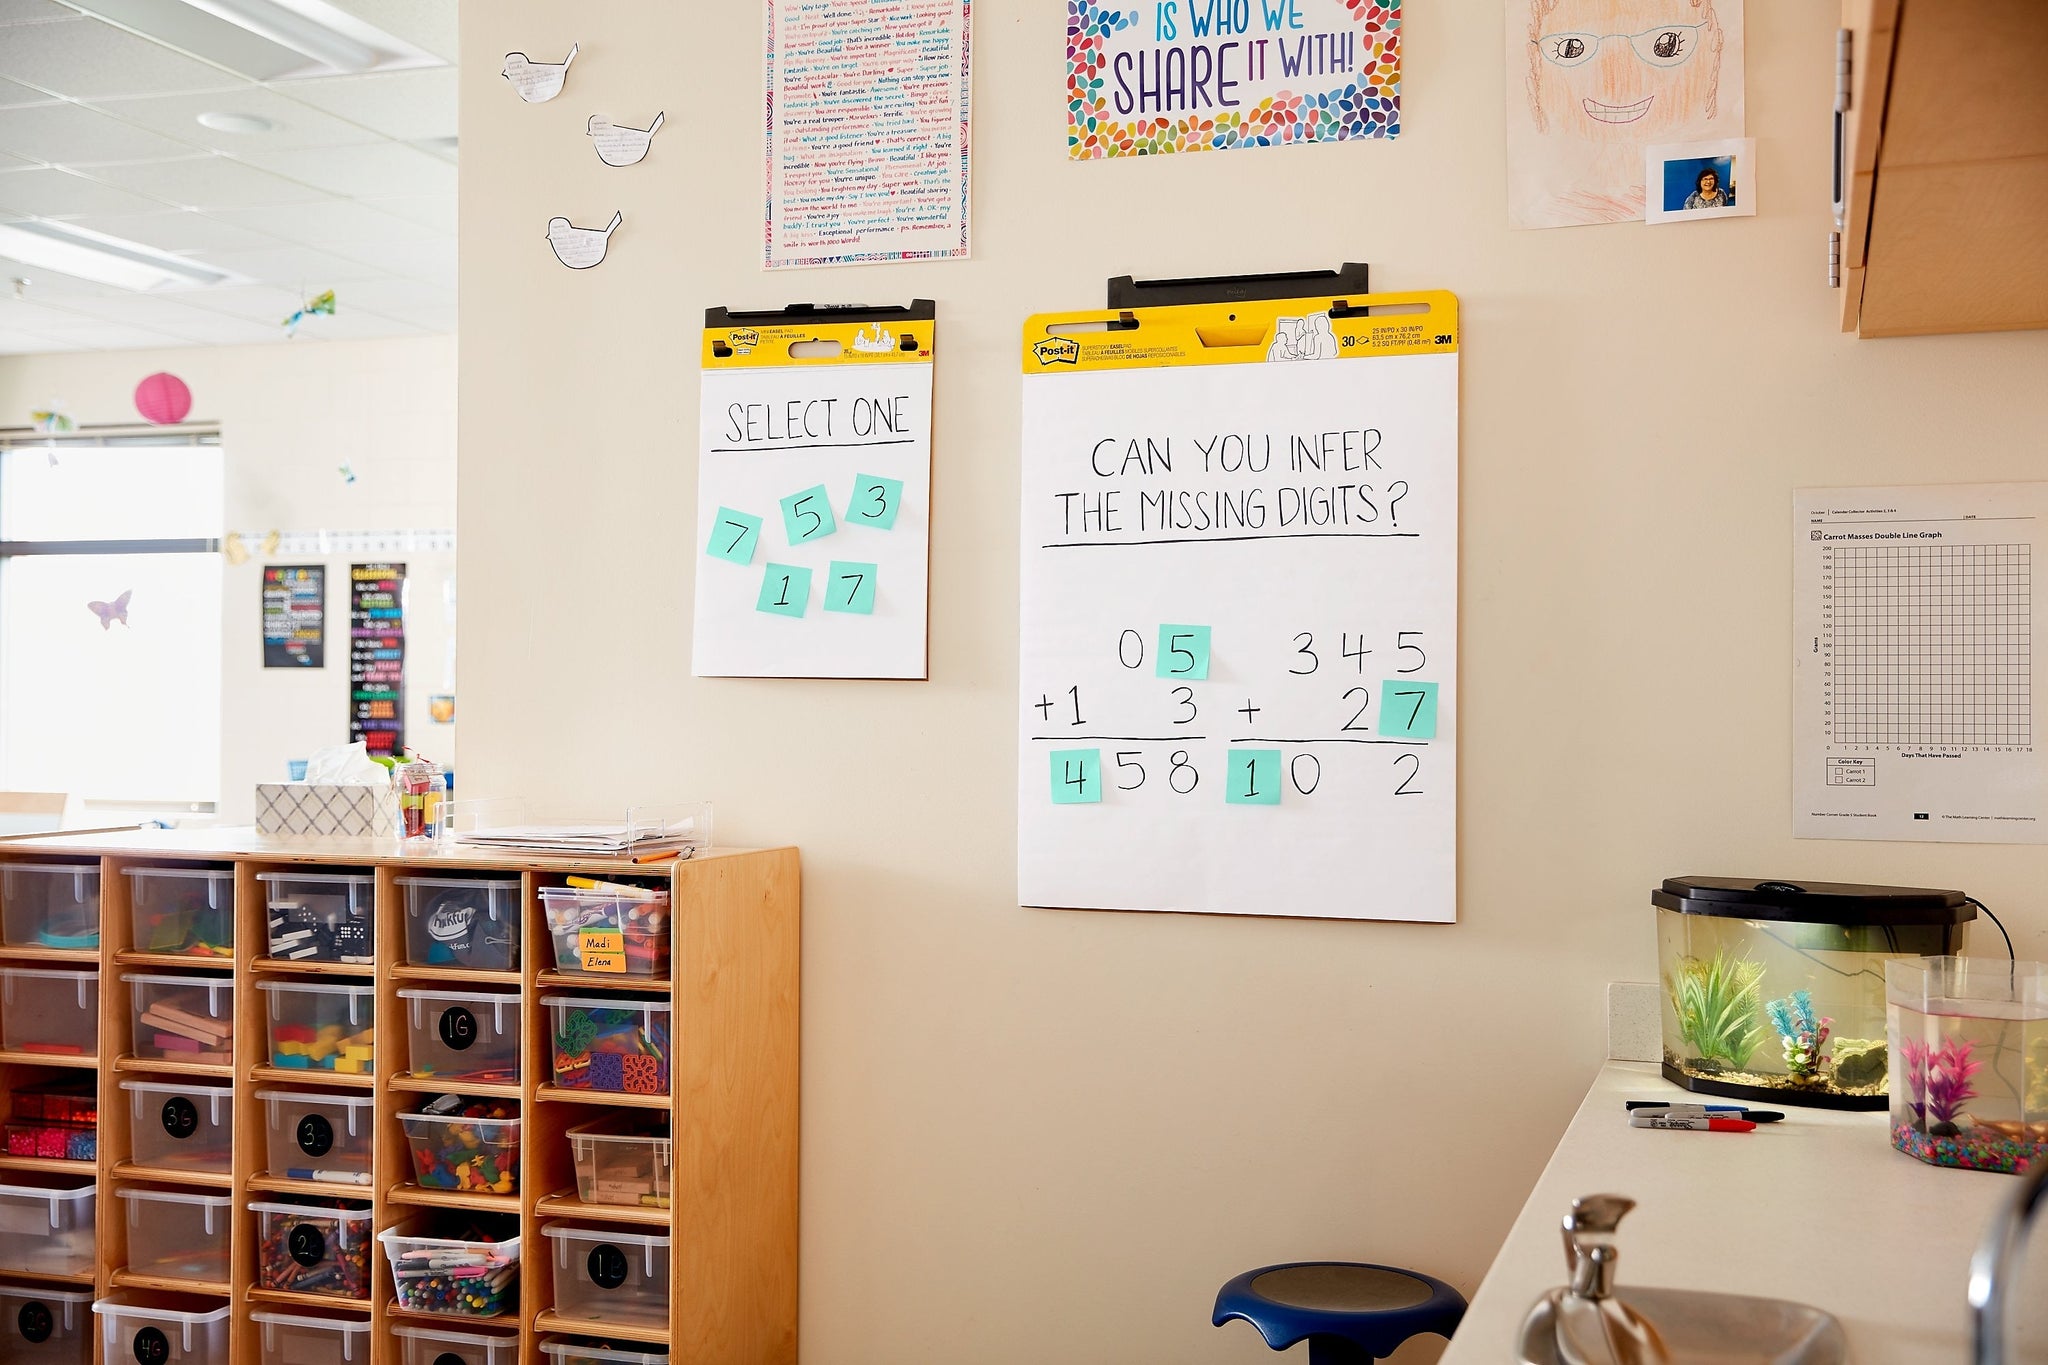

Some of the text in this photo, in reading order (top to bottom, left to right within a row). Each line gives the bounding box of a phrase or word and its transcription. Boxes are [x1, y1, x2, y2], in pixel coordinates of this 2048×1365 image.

[916, 11, 936, 19] Looking
[1156, 0, 1304, 41] IS WHO WE
[864, 34, 891, 42] incredible
[817, 46, 842, 54] Beautiful
[804, 73, 838, 82] Spectacular
[878, 76, 899, 84] Nothing
[1113, 31, 1354, 115] SHARE IT WITH!
[886, 134, 931, 144] That's correct
[900, 187, 925, 195] Beautiful
[819, 226, 894, 236] Exceptional performance
[732, 333, 756, 341] Post-it
[1341, 336, 1355, 347] 30
[1434, 335, 1452, 344] 3M
[1040, 345, 1075, 356] Post-it
[726, 396, 909, 442] SELECT ONE
[1091, 428, 1382, 477] CAN YOU INFER
[861, 485, 886, 518] 3
[1054, 480, 1409, 535] THE MISSING DIGITS?
[794, 495, 821, 538] 5
[725, 520, 749, 553] 7
[1919, 531, 1942, 540] Graph
[773, 575, 789, 606] 1
[841, 574, 863, 605] 7
[1118, 629, 1195, 673] 0 5
[1171, 686, 1197, 724] 3
[1341, 686, 1370, 731] 2
[1394, 691, 1426, 730] 7
[1290, 753, 1321, 795] 0
[1393, 753, 1424, 795] 2
[586, 937, 610, 948] Madi
[587, 957, 611, 966] Elena
[449, 1014, 468, 1038] 1G
[167, 1106, 192, 1126] 3G
[142, 1339, 161, 1358] 4G
